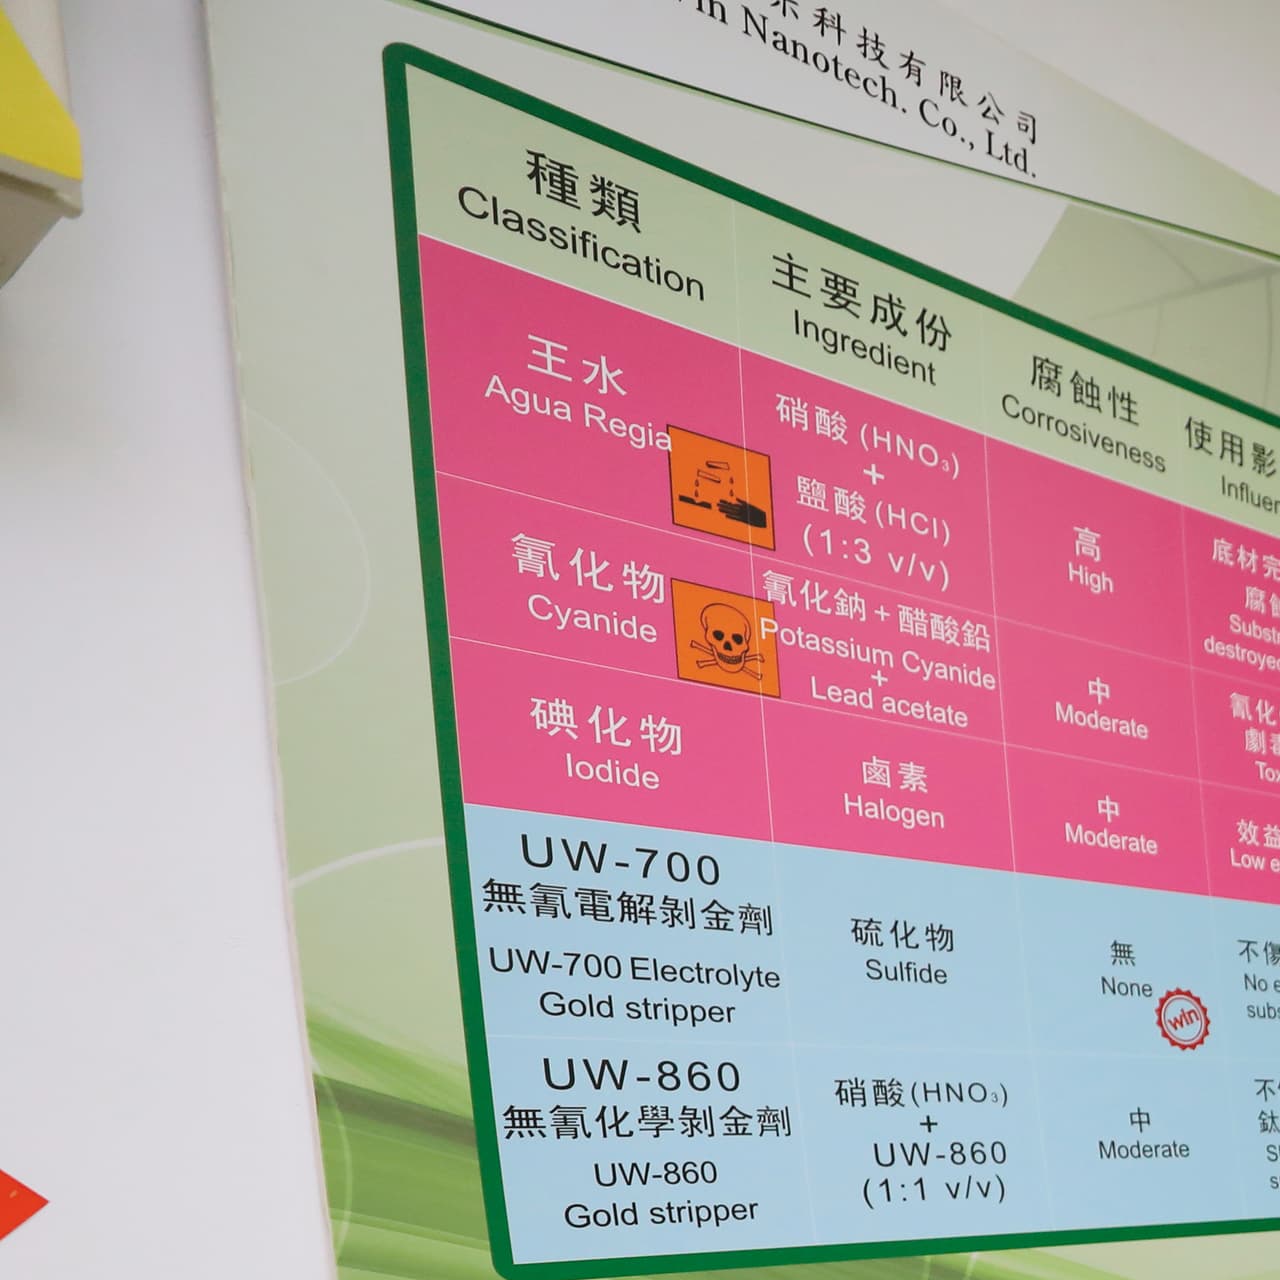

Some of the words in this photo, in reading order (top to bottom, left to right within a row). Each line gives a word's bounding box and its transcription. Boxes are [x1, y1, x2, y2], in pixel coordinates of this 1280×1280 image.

[741, 4, 907, 113] Nanotech.
[919, 99, 974, 151] Co.,
[986, 129, 1037, 178] Ltd.
[525, 149, 641, 234] 種類
[459, 186, 705, 303] Classification
[771, 252, 953, 354] 主要成份
[527, 334, 628, 396] 王水
[794, 310, 936, 387] Ingredient
[1031, 354, 1139, 426] 腐蝕性
[485, 375, 572, 422] Agua
[583, 404, 673, 453] Regia
[1001, 394, 1166, 473] Corrosiveness
[1073, 525, 1102, 563] 高
[511, 533, 665, 604] 氰化物
[888, 560, 950, 592] v/v)
[1068, 562, 1115, 594] High
[528, 594, 657, 644] Cyanide
[760, 616, 895, 668] Potassium
[902, 651, 997, 692] Cyanide
[811, 676, 873, 710] Lead
[882, 693, 969, 728] acetate
[1088, 676, 1110, 705] 中
[530, 697, 683, 757] 碘化物
[1055, 701, 1148, 740] Moderate
[565, 752, 661, 790] Iodide
[862, 755, 929, 794] 鹵素
[844, 792, 945, 829] Halogen
[1097, 795, 1120, 823] 中
[1064, 822, 1158, 855] Moderate
[521, 833, 721, 886] UW-700
[1230, 848, 1265, 871] Low
[481, 877, 774, 938] 無氰電解剝金劑
[850, 917, 956, 953] 硫化物
[1110, 939, 1136, 967] 無
[489, 946, 622, 980] UW-700
[629, 956, 781, 989] Electrolyte
[865, 959, 948, 985] Sulfide
[1100, 975, 1153, 997] None
[1243, 974, 1268, 992] No
[538, 991, 615, 1018] Gold
[626, 997, 736, 1027] stripper
[542, 1057, 741, 1092] UW-860
[503, 1103, 793, 1141] 無氰化學剝金劑
[1129, 1106, 1151, 1134] 中
[873, 1139, 1008, 1168] UW-860
[1098, 1139, 1190, 1160] Moderate
[594, 1160, 718, 1188] UW-860
[945, 1174, 1007, 1202] v/v)
[564, 1203, 640, 1228] Gold
[649, 1197, 759, 1228] stripper
